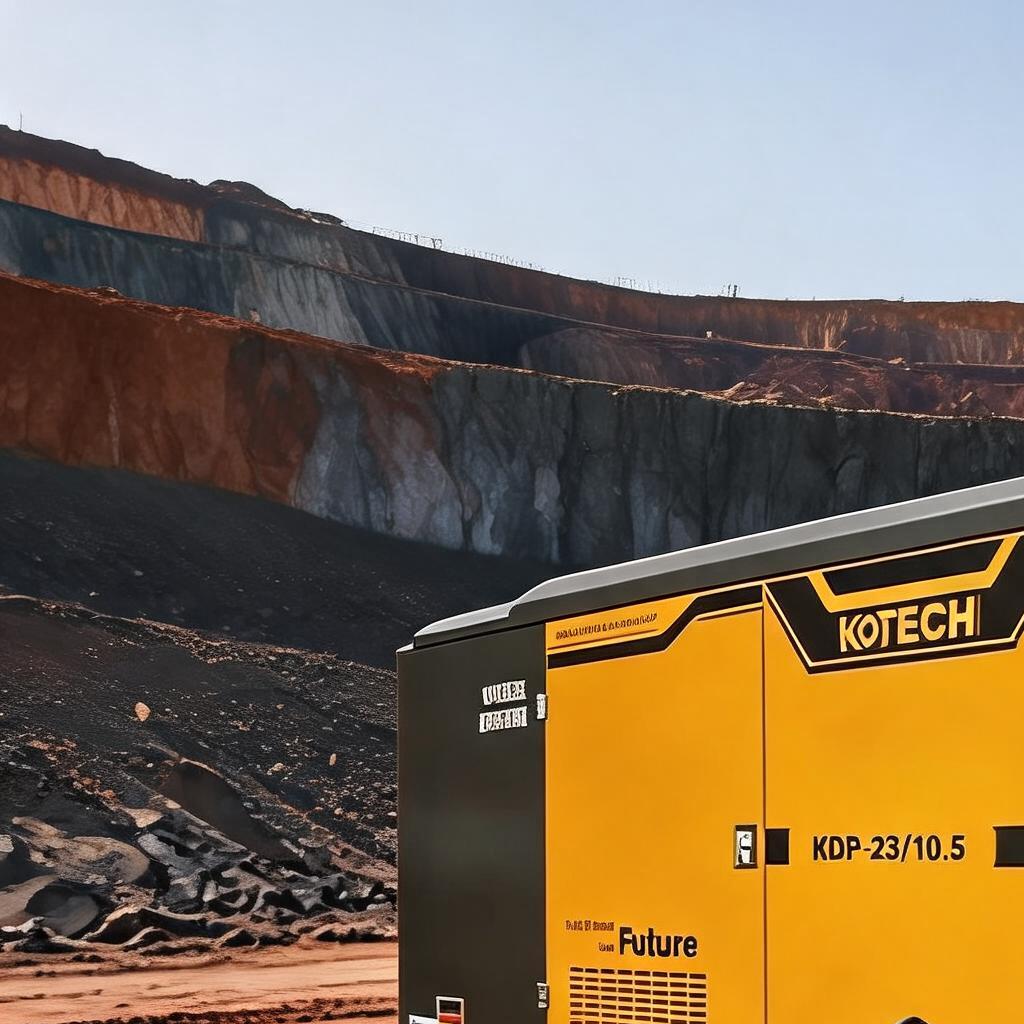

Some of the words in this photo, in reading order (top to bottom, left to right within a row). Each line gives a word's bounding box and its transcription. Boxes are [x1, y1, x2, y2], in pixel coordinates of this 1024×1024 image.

[839, 595, 976, 652] KOTECH
[813, 834, 966, 862] KDP-23/10.5
[619, 926, 698, 957] Future
